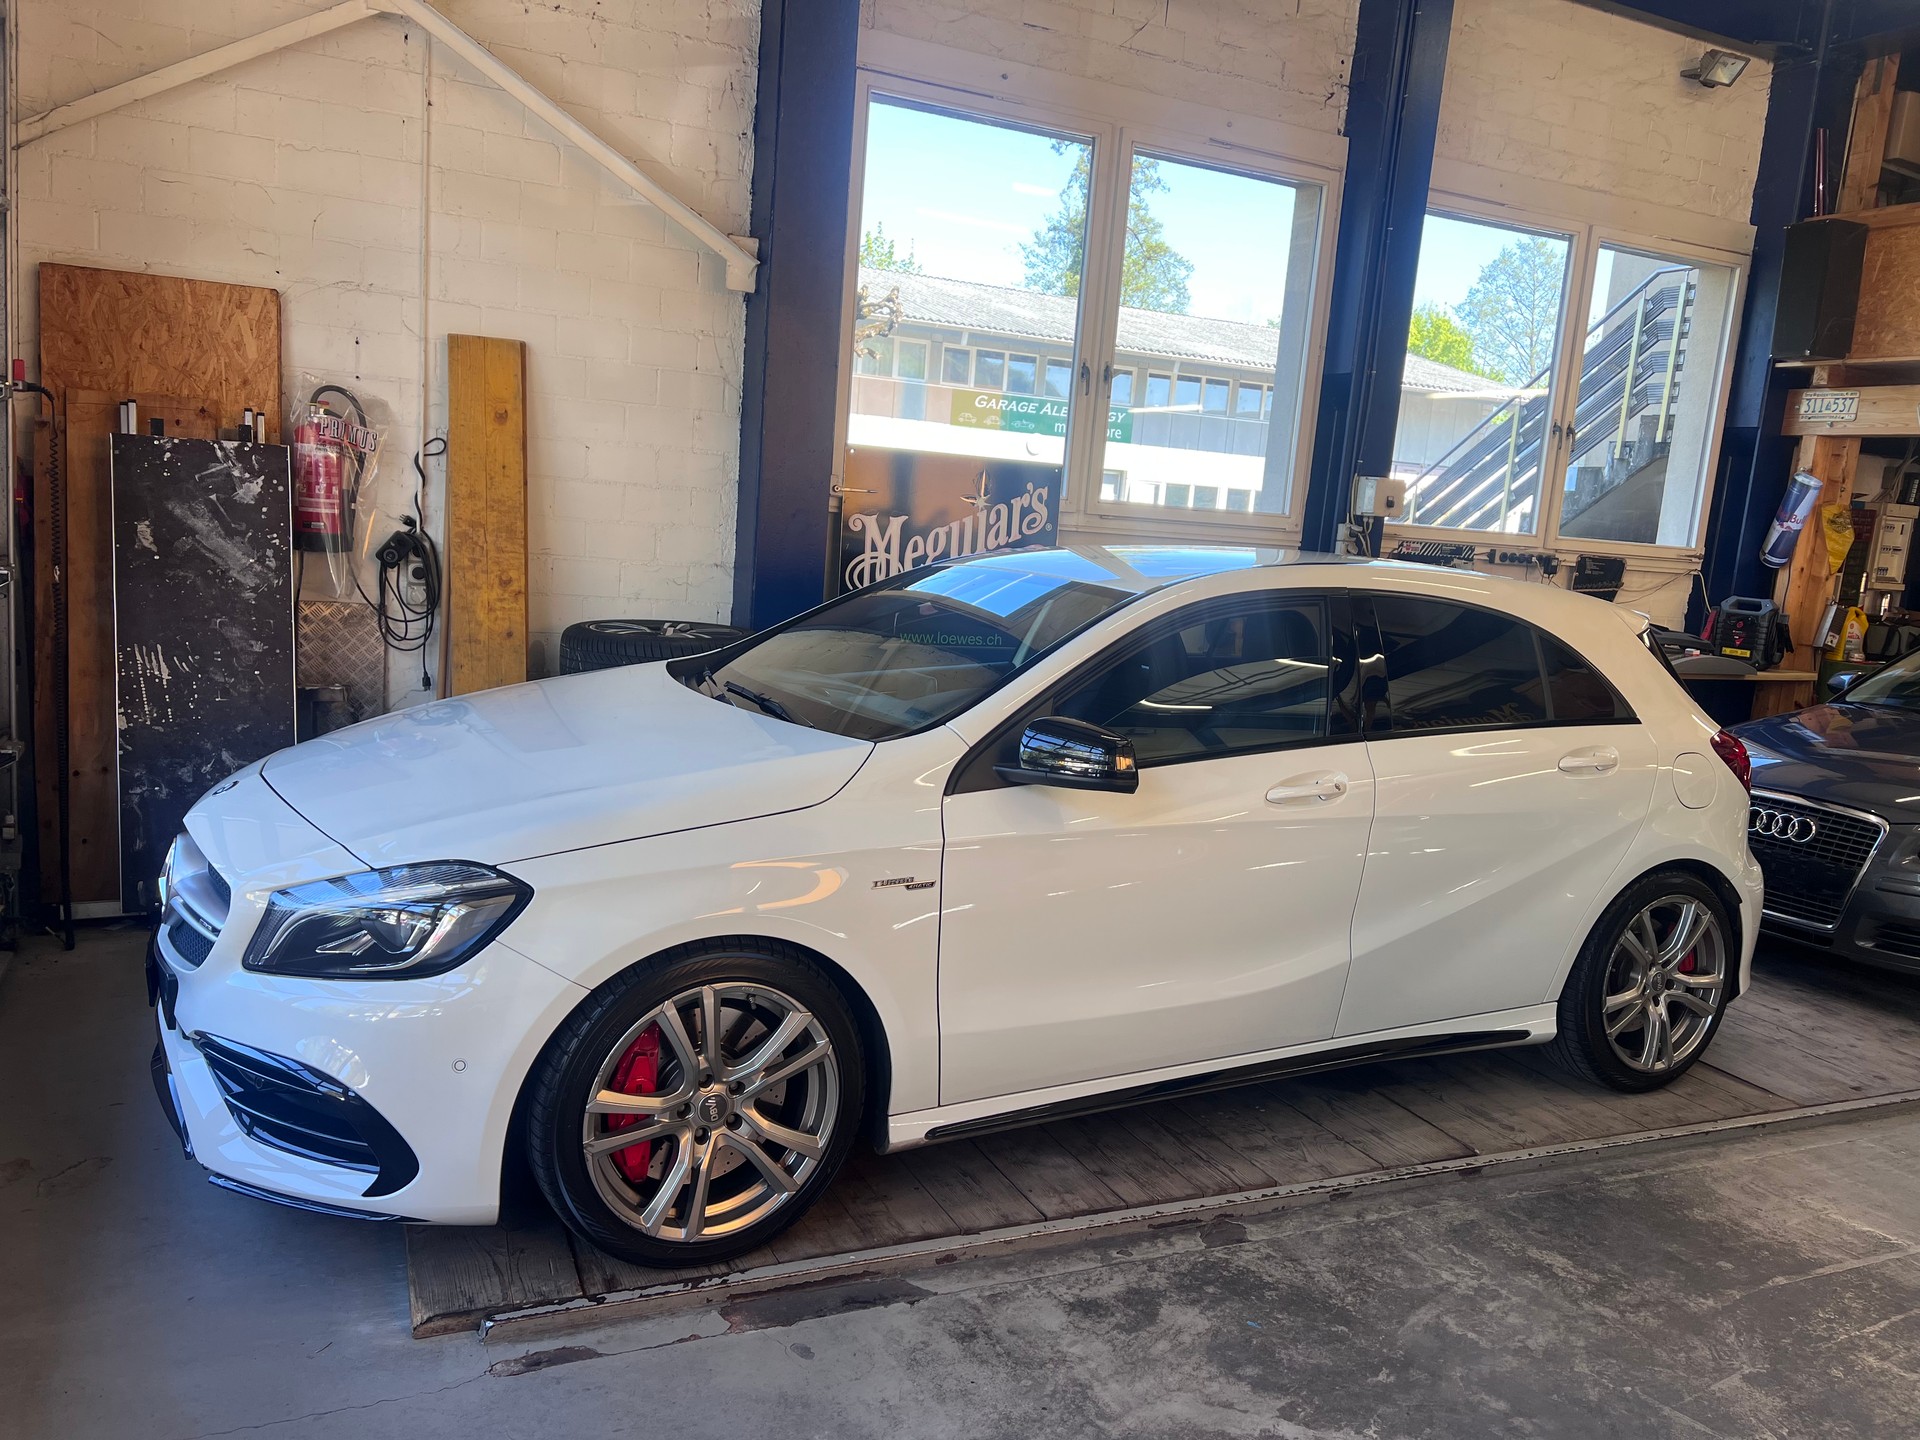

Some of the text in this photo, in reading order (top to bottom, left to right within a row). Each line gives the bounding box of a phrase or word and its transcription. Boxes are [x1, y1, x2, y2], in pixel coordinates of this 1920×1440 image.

[974, 394, 1039, 415] GARAGE
[319, 416, 378, 452] PRIMUS
[844, 482, 1049, 591] Meguiar's
[900, 631, 1002, 646] www.loewes.ch
[873, 876, 914, 887] TURBO
